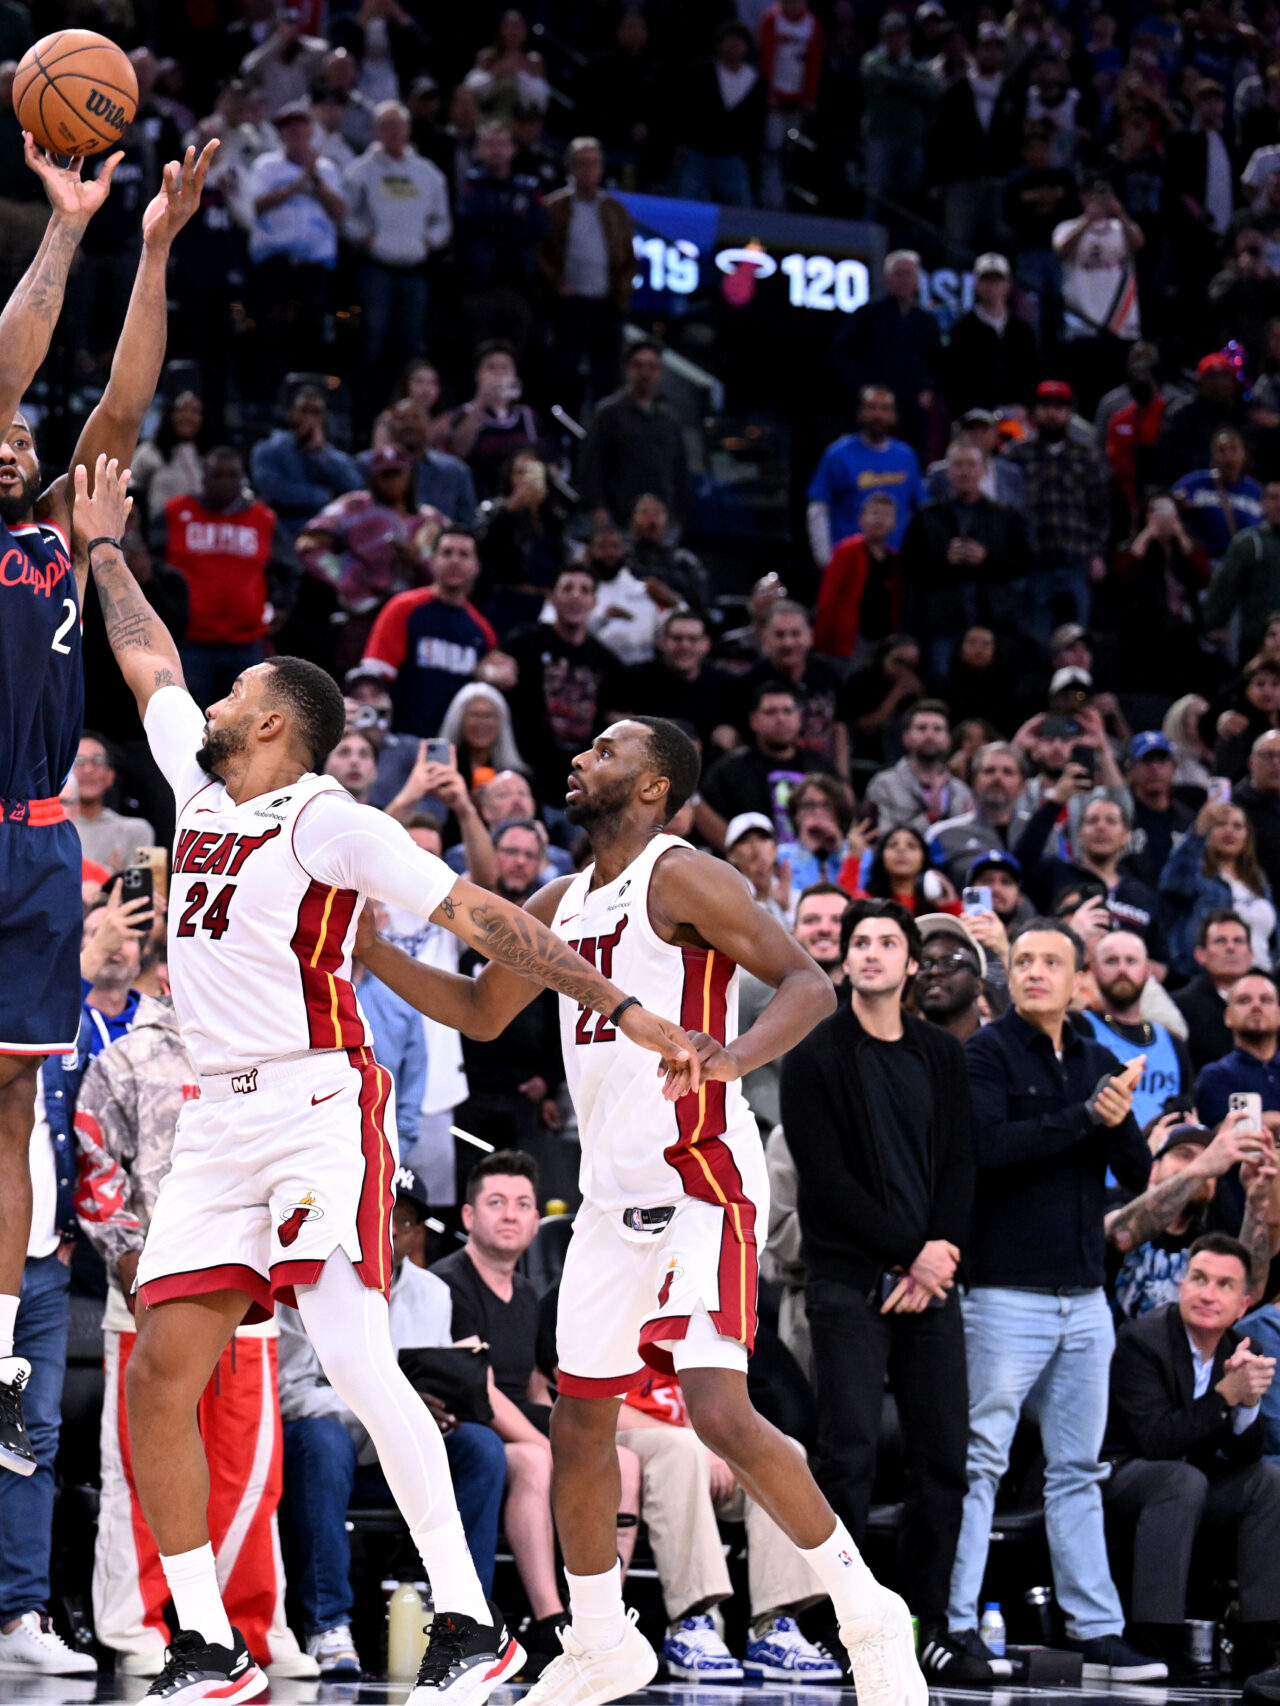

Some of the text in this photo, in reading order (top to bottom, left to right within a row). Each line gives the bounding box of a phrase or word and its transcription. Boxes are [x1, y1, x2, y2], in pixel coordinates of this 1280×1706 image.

[781, 253, 869, 313] 120
[51, 598, 77, 655] 2
[253, 810, 287, 822] Robinhood
[172, 823, 282, 877] HEAT
[176, 881, 238, 940] 24
